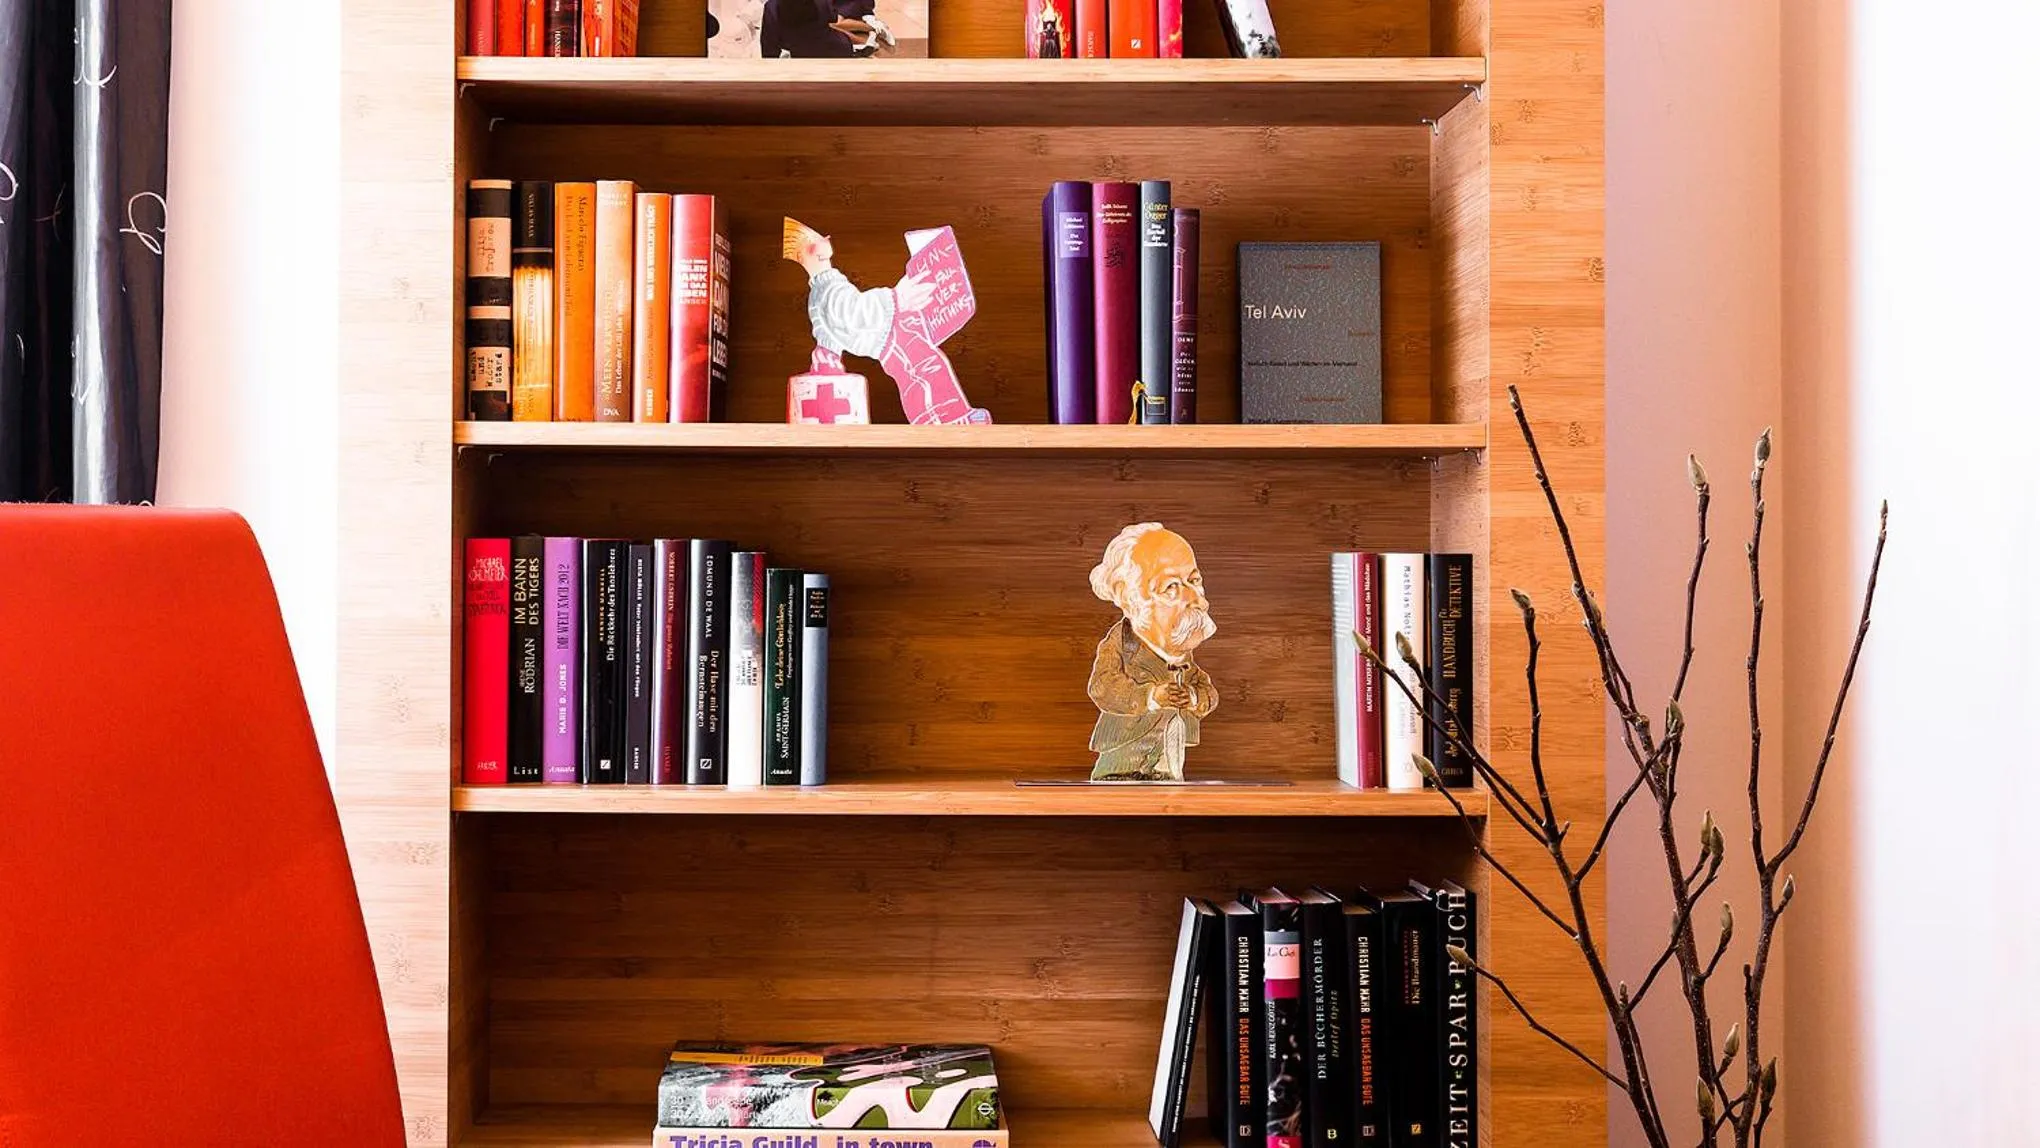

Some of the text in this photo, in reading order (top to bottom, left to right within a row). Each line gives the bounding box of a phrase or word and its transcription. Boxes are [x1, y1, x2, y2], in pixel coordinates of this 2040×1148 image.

[1245, 304, 1308, 319] Tel Aviv
[513, 557, 527, 625] IM BANN
[528, 557, 540, 626] DES TIGERS
[556, 563, 570, 585] 2012
[556, 586, 570, 610] NACH
[704, 554, 715, 639] EDMUND DE WAAL
[1403, 565, 1412, 609] Mathias
[1448, 564, 1462, 619] DETEKTIVE
[556, 612, 570, 637] WELT
[1442, 619, 1457, 679] HANDBUCH
[524, 637, 536, 694] RODRIAN
[606, 648, 616, 662] Die
[557, 663, 568, 735] MARIE D. JONES
[696, 654, 708, 728] Bernsteinaugen
[708, 649, 720, 733] Der Hase mit den
[1365, 686, 1374, 712] MARTIN
[513, 765, 540, 775] List
[1237, 936, 1251, 1106] CHRISTIAN MÄHR DAS UNSAGBAR GUTE
[1312, 938, 1327, 1080] DER BÜCHERMÖRDER
[1358, 936, 1374, 1106] CHRISTIAN MÄHR DAS UNSAGBAR GUTE
[1447, 993, 1469, 1069] SPAR
[669, 1136, 934, 1148] Tricia Guild in town
